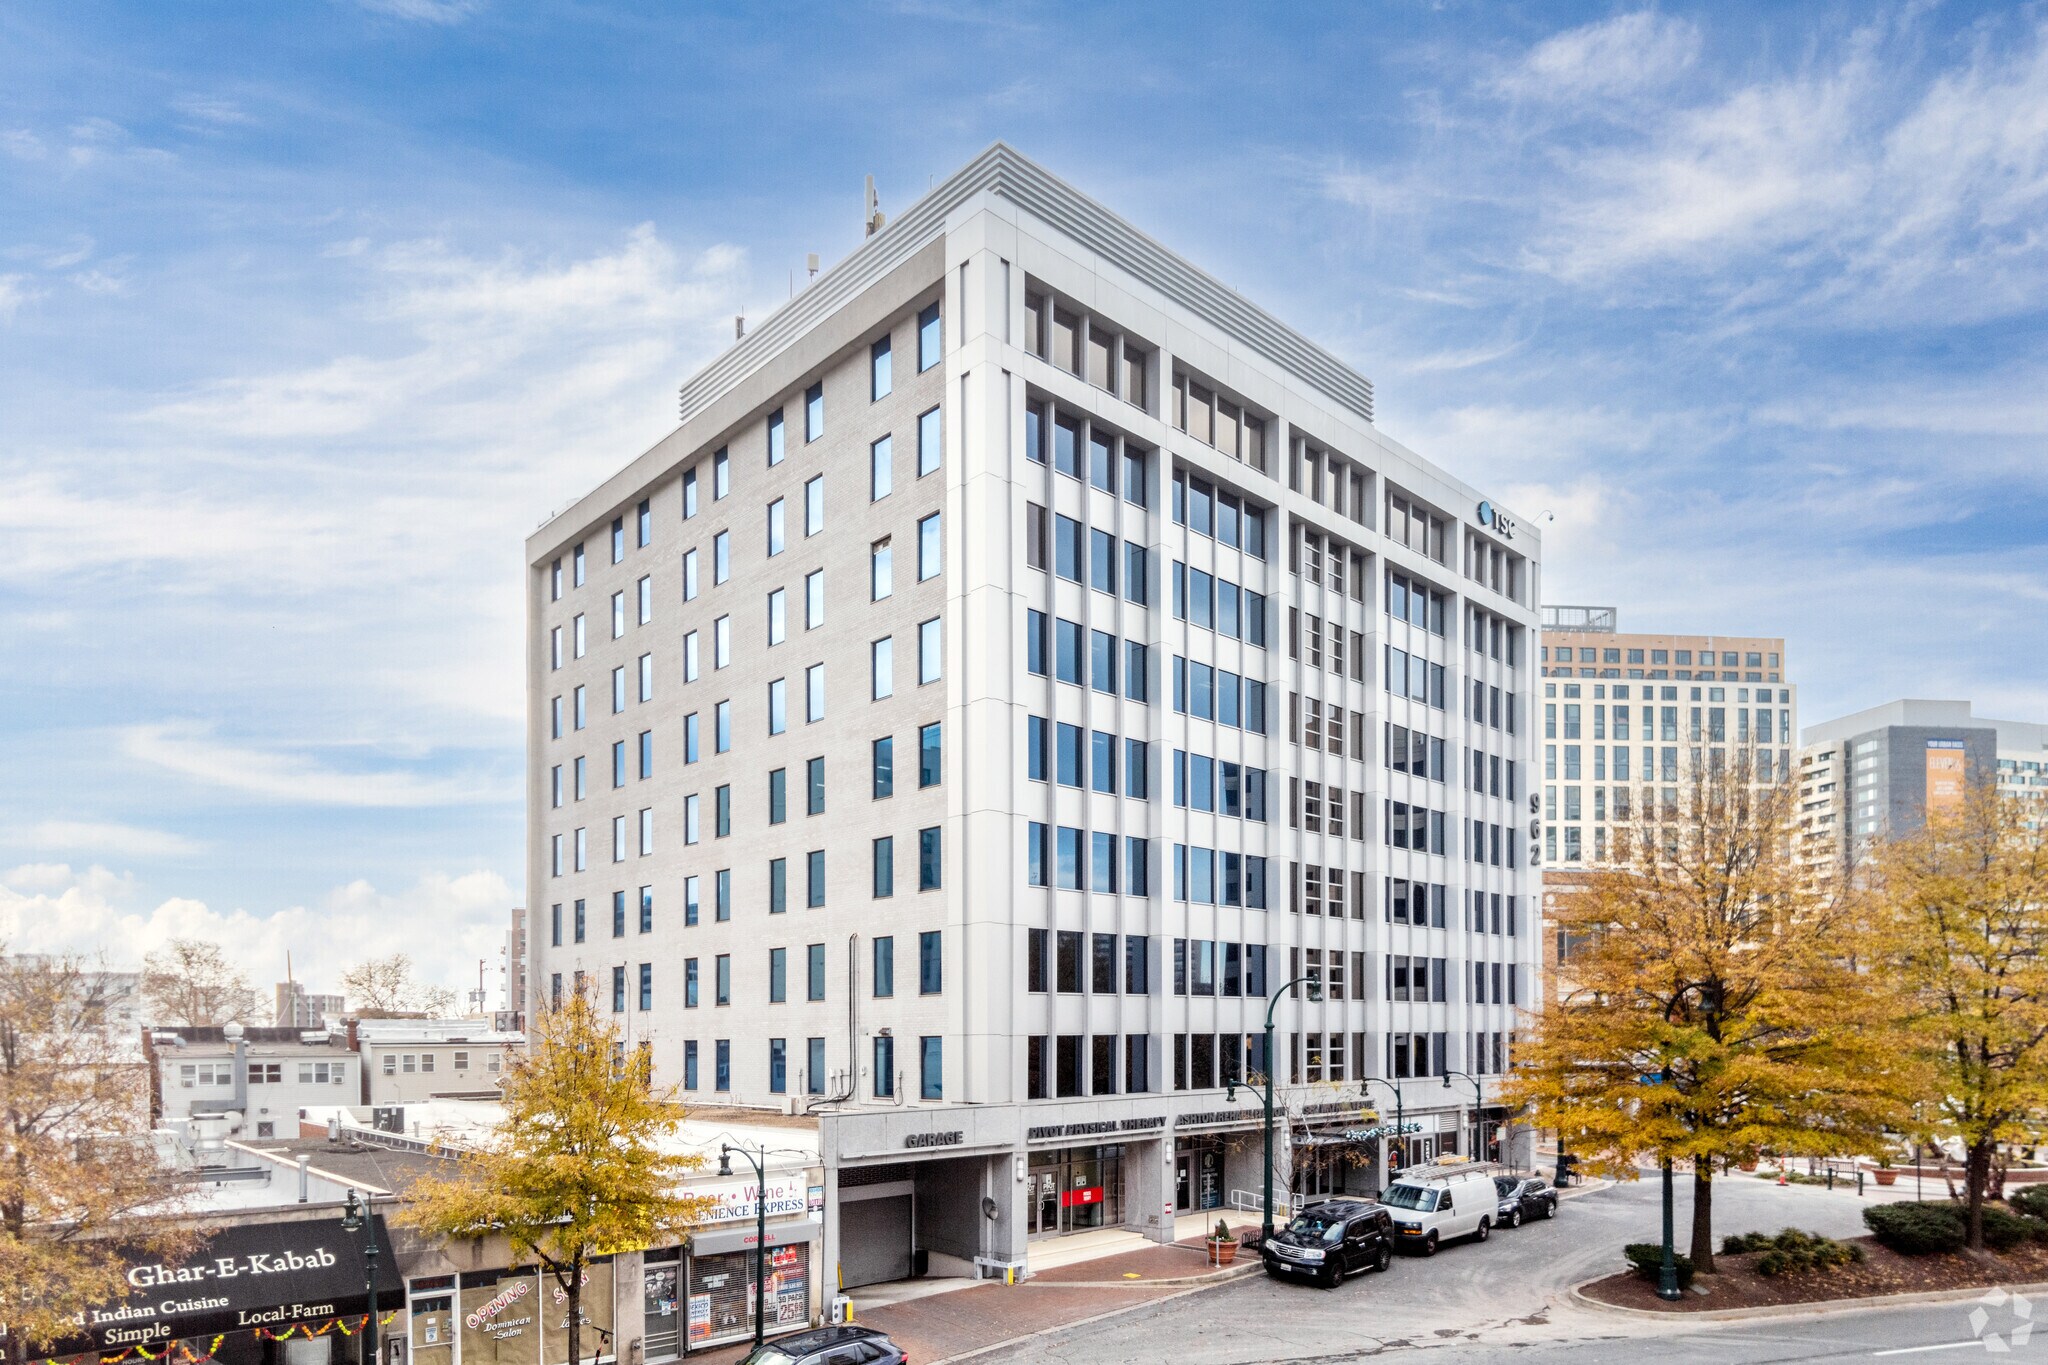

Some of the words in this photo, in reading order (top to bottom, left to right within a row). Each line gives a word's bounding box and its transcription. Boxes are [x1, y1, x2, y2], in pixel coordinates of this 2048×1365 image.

[1491, 508, 1516, 539] TSC
[1530, 792, 1541, 866] 962
[1028, 1125, 1065, 1139] PIVOT
[1065, 1121, 1119, 1136] PHYSICAL
[1121, 1116, 1167, 1130] THERAPY
[1175, 1112, 1215, 1126] ASHTON
[1215, 1107, 1285, 1123] REHABILITAION
[905, 1131, 964, 1149] GARAGE
[744, 1186, 784, 1202] Wne
[698, 1205, 750, 1222] ENIENCE
[743, 1234, 776, 1244] CORELL
[128, 1247, 336, 1287] Ghar-E-Kabab
[91, 1306, 156, 1323] Indian
[160, 1297, 229, 1314] Cuisine
[238, 1303, 335, 1326] Local-Farm
[466, 1281, 528, 1329] OPENING
[105, 1321, 171, 1345] Simple
[483, 1316, 531, 1332] Dominican
[493, 1328, 522, 1340] Salon
